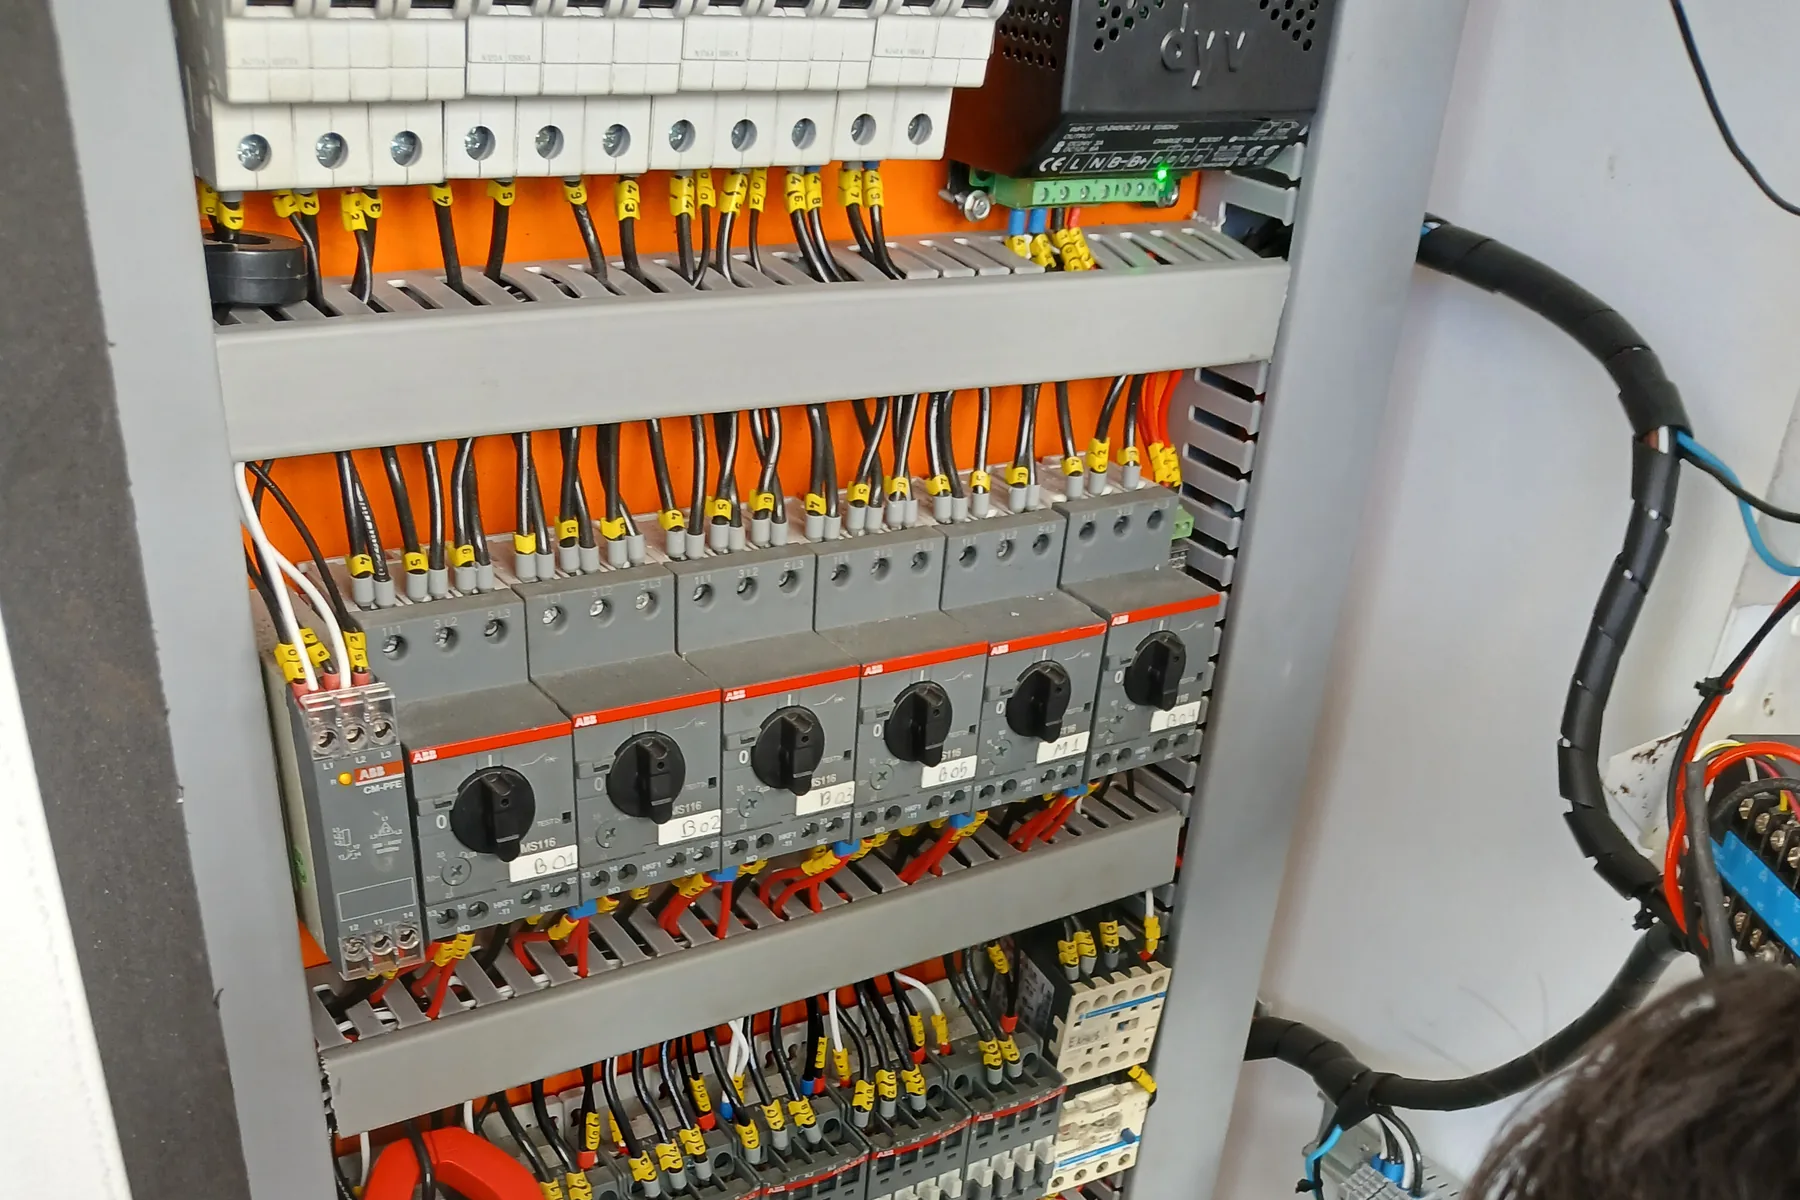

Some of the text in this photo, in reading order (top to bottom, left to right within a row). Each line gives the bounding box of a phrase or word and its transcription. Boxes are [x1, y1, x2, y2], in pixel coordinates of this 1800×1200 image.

[1089, 157, 1106, 169] N
[1112, 615, 1130, 625] ABB
[990, 645, 1009, 655] ABB
[864, 664, 883, 675] ABB
[1114, 670, 1124, 684] 0
[725, 690, 746, 701] ABB
[995, 701, 1005, 715] 0
[574, 715, 597, 727] ABB
[873, 724, 882, 737] 0
[355, 755, 367, 764] L2
[380, 751, 392, 759] L3
[413, 750, 437, 763] ABB
[739, 750, 749, 764] 0
[323, 762, 334, 770] L1
[360, 766, 385, 780] ABB
[363, 780, 402, 794] CM-PFE
[594, 777, 604, 791] 0
[435, 815, 447, 829] 0
[520, 838, 557, 853] MS116
[877, 1150, 894, 1158] ABB
[768, 1186, 785, 1194] ABB
